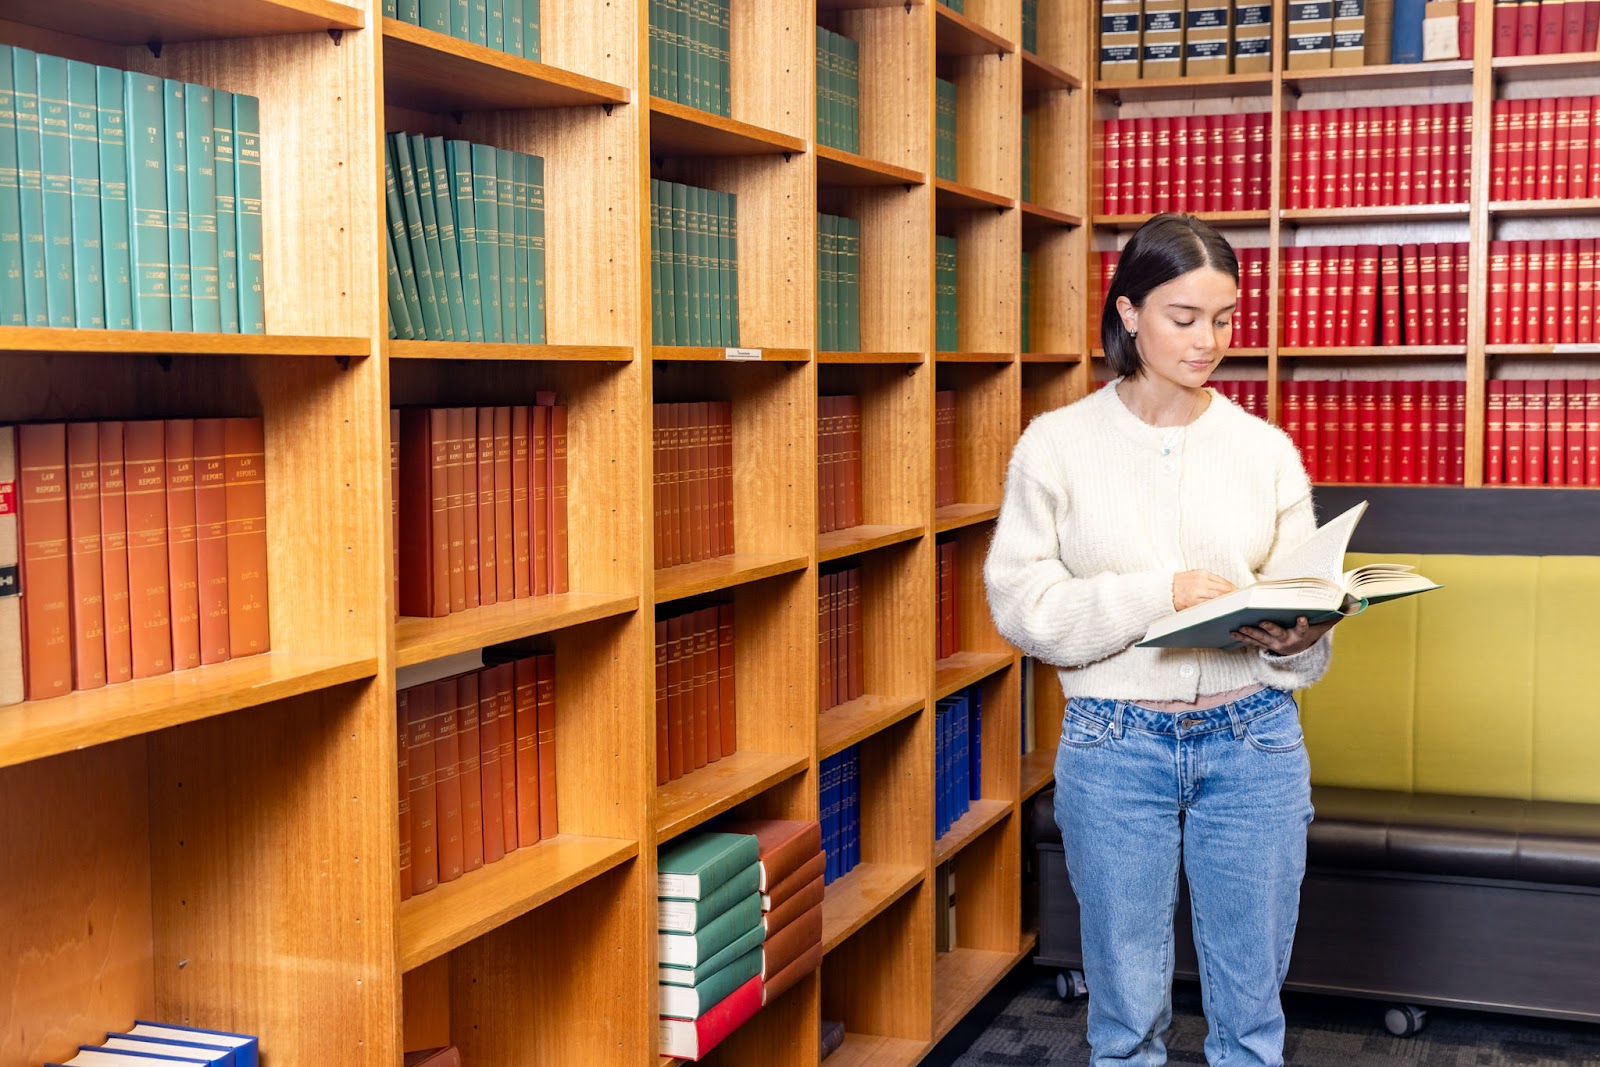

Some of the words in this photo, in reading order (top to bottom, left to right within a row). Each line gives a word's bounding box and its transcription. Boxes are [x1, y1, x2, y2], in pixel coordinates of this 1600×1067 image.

[242, 149, 259, 158] REPORTS
[143, 466, 156, 474] LAW
[177, 464, 189, 472] LAW
[207, 462, 219, 470] LAW
[41, 473, 55, 481] LAW
[81, 470, 94, 478] LAW
[201, 473, 224, 481] REPORTS
[236, 469, 257, 478] REPORTS
[138, 477, 161, 486] REPORTS
[172, 474, 194, 483] REPORTS
[36, 485, 61, 494] REPORTS
